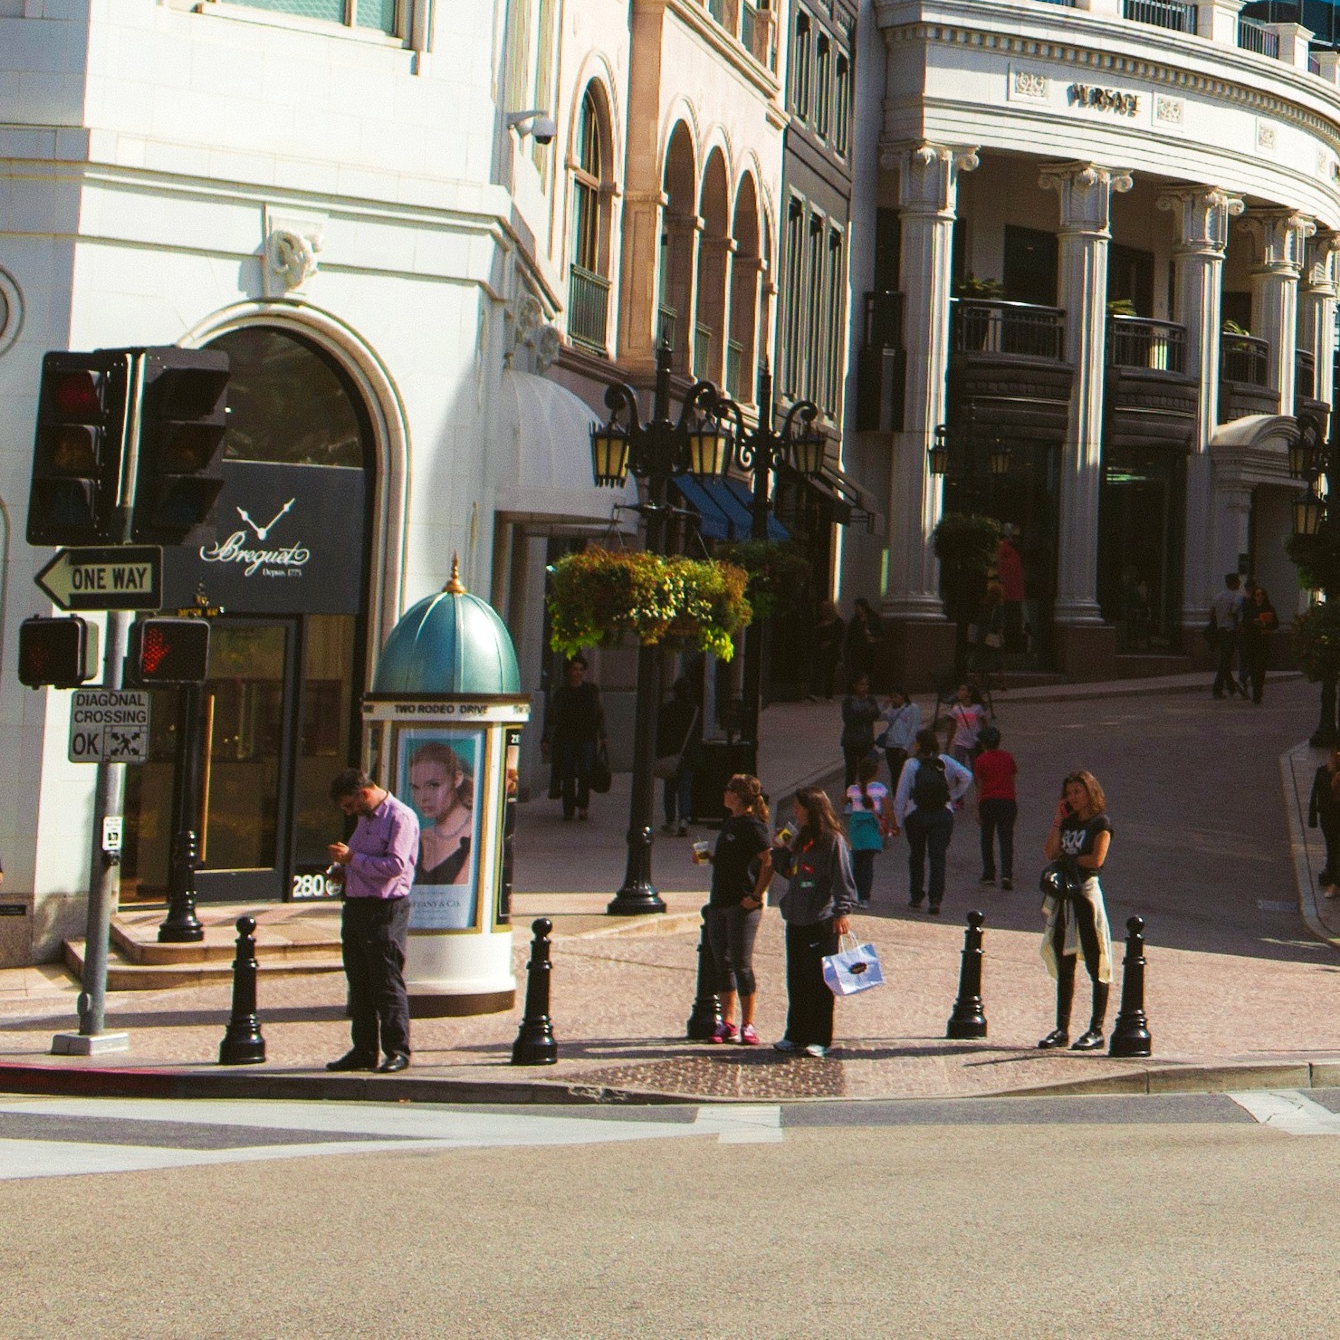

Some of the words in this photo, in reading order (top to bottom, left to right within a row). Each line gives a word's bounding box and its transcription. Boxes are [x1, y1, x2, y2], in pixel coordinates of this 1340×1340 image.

[200, 531, 310, 577] Breguet
[72, 568, 105, 590] ONE
[112, 567, 148, 589] WAY
[76, 693, 145, 707] DIAGONAL
[394, 705, 416, 714] TWO
[419, 705, 455, 714] RODEO
[459, 704, 488, 715] DRIVE
[74, 710, 146, 723] CROSSING
[72, 732, 100, 756] OK
[292, 874, 324, 898] 280
